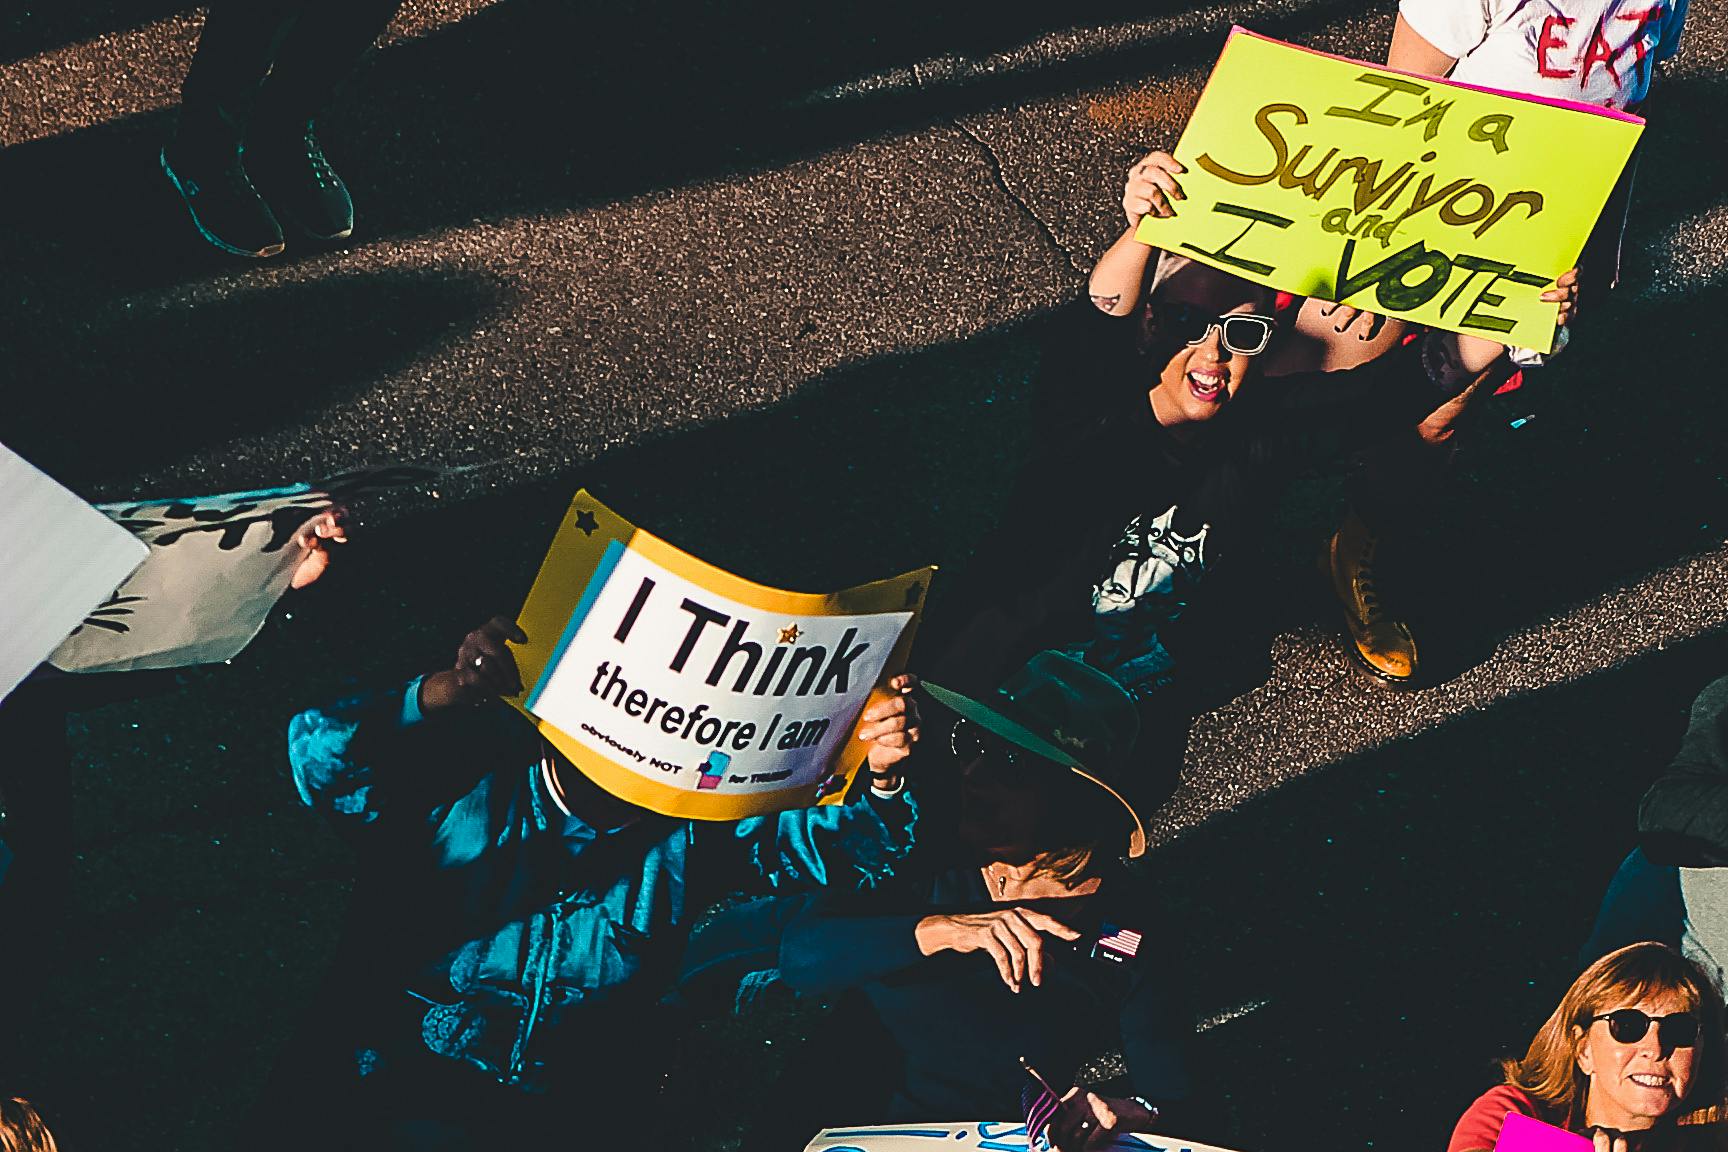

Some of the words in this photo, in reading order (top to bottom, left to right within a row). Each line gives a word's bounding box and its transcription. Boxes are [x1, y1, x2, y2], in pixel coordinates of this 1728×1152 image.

[1537, 4, 1663, 92] EAT
[1196, 103, 1544, 239] Survivor
[1467, 113, 1515, 155] a
[1180, 201, 1294, 277] I
[1334, 239, 1554, 334] VOTE
[612, 576, 657, 645] I
[668, 597, 871, 698] Think
[580, 722, 647, 763] obviously
[648, 756, 683, 775] NOT
[589, 660, 762, 752] therefore
[761, 713, 784, 752] I
[779, 716, 832, 752] am
